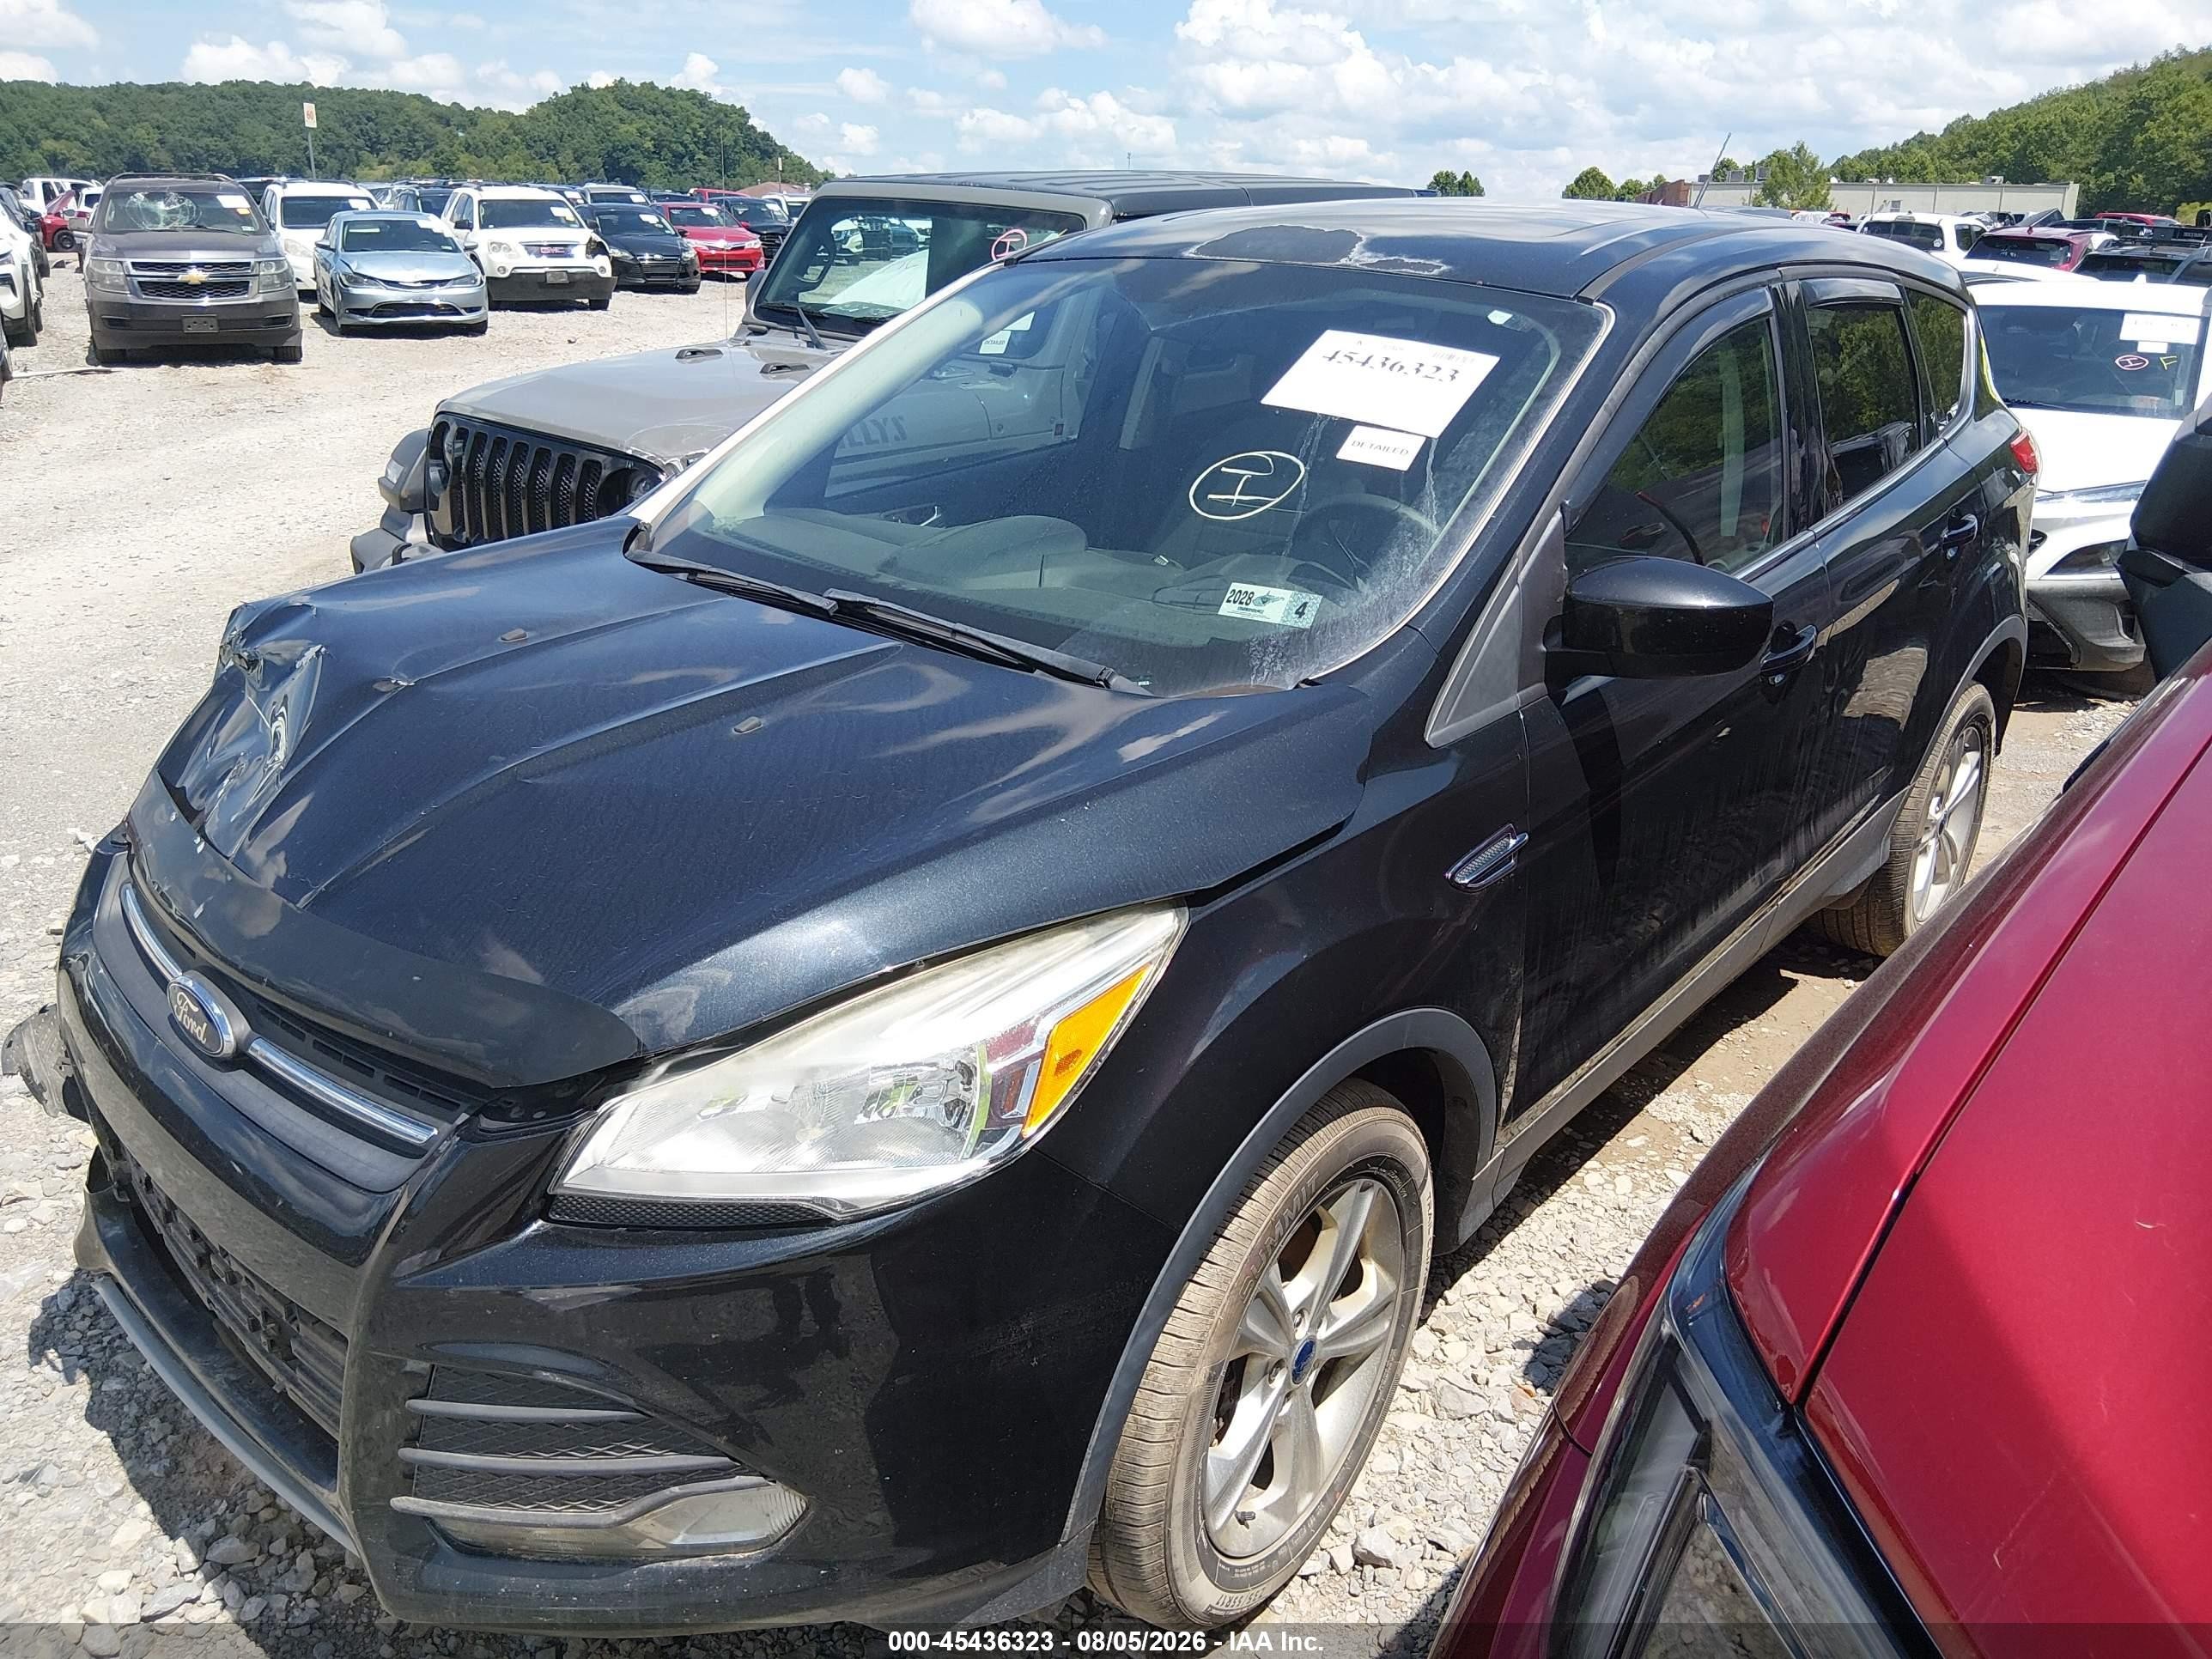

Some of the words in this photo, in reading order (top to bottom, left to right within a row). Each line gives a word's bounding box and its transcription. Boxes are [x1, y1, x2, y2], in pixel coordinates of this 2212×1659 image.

[1322, 349, 1460, 382] 45436323
[1351, 440, 1409, 456] DETAILED
[1225, 588, 1255, 606] 2028
[1294, 601, 1309, 618] 4
[174, 991, 208, 1044] Ford
[1239, 1170, 1320, 1304] SUMMIT
